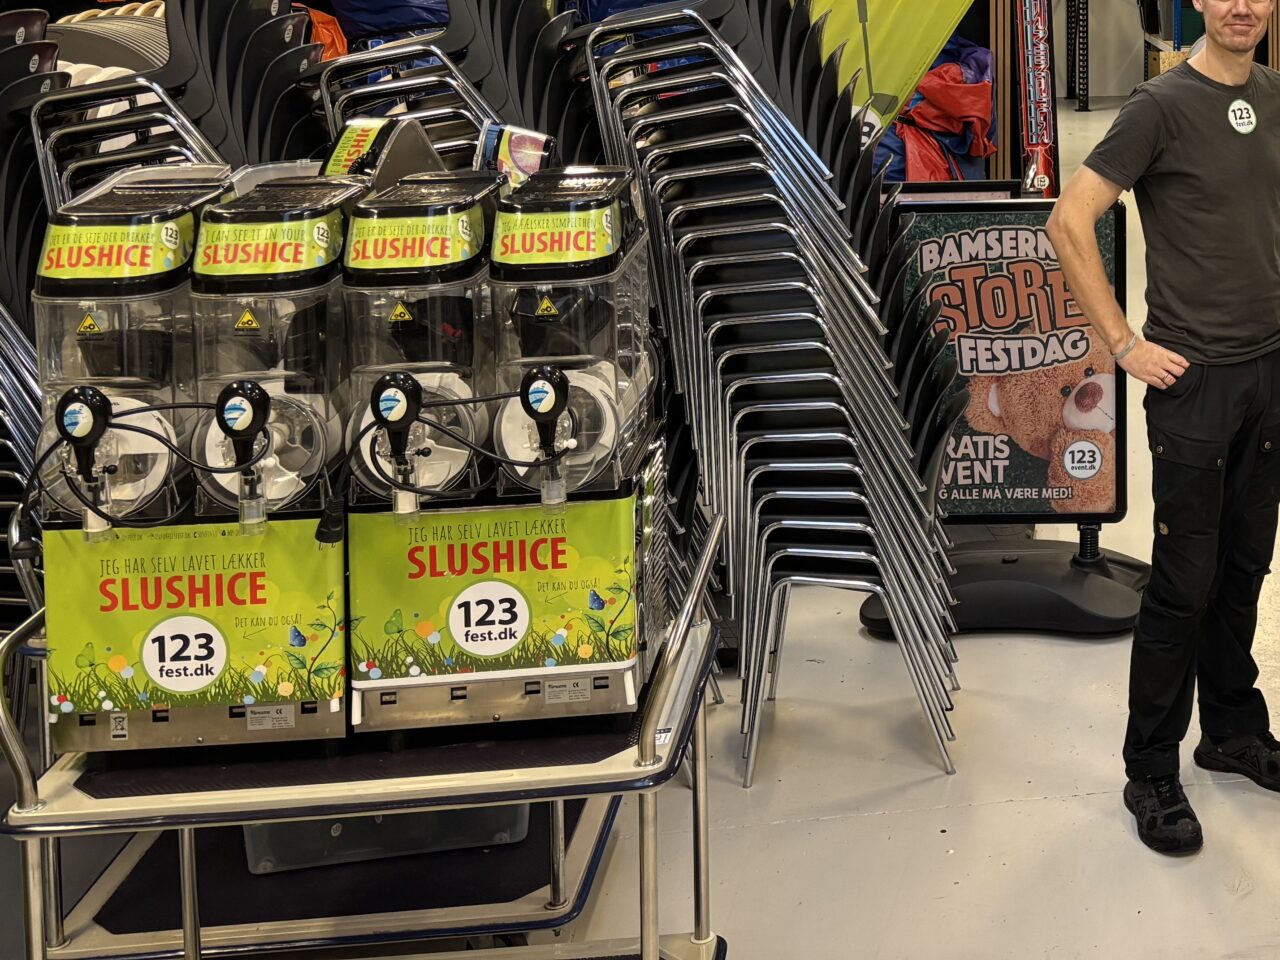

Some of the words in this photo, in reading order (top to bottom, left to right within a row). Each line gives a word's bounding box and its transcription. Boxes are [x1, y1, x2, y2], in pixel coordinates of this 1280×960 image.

[1231, 108, 1251, 120] 123
[74, 233, 82, 244] DE
[165, 227, 178, 240] 123
[211, 230, 229, 243] CAN
[234, 229, 247, 241] SEE
[251, 229, 260, 241] IT
[264, 228, 277, 241] IN
[316, 227, 330, 239] 123
[500, 231, 597, 256] SLUSHICE
[44, 244, 152, 270] SLUSHICE
[202, 242, 304, 266] SLUSHICE
[351, 237, 451, 262] SLUSHICE
[922, 229, 1058, 272] BAMSERN
[932, 260, 1092, 339] STORE
[960, 331, 1087, 371] FESTDAG
[946, 436, 1010, 459] RATIS
[1068, 449, 1097, 464] 123
[942, 459, 1010, 485] VENT
[1070, 464, 1097, 472] event.dk
[951, 488, 979, 500] ALLE
[982, 485, 1002, 499] MÅ
[1006, 487, 1039, 499] VÆRE
[1042, 486, 1073, 499] MED!
[408, 526, 428, 546] JEG
[431, 524, 453, 541] HAR
[457, 522, 482, 540] SELV
[487, 520, 520, 538] LAVET
[525, 518, 567, 536] LÆKKER
[100, 558, 120, 577] JEG
[125, 557, 146, 574] HAR
[151, 555, 177, 573] SELV
[182, 554, 216, 572] LAVET
[222, 552, 266, 569] LÆKKER
[407, 537, 568, 580] SLUSHICE
[99, 571, 267, 613] SLUSHICE
[537, 581, 551, 593] DET
[552, 581, 567, 592] KAN
[569, 580, 579, 590] DU
[235, 616, 248, 628] DET
[250, 616, 266, 627] KAN
[268, 615, 279, 626] DU
[281, 614, 302, 626] OGSÅ!
[457, 597, 519, 628] 123
[464, 628, 518, 643] fest.dk
[151, 633, 215, 663] 123
[158, 664, 214, 679] fest.dk
